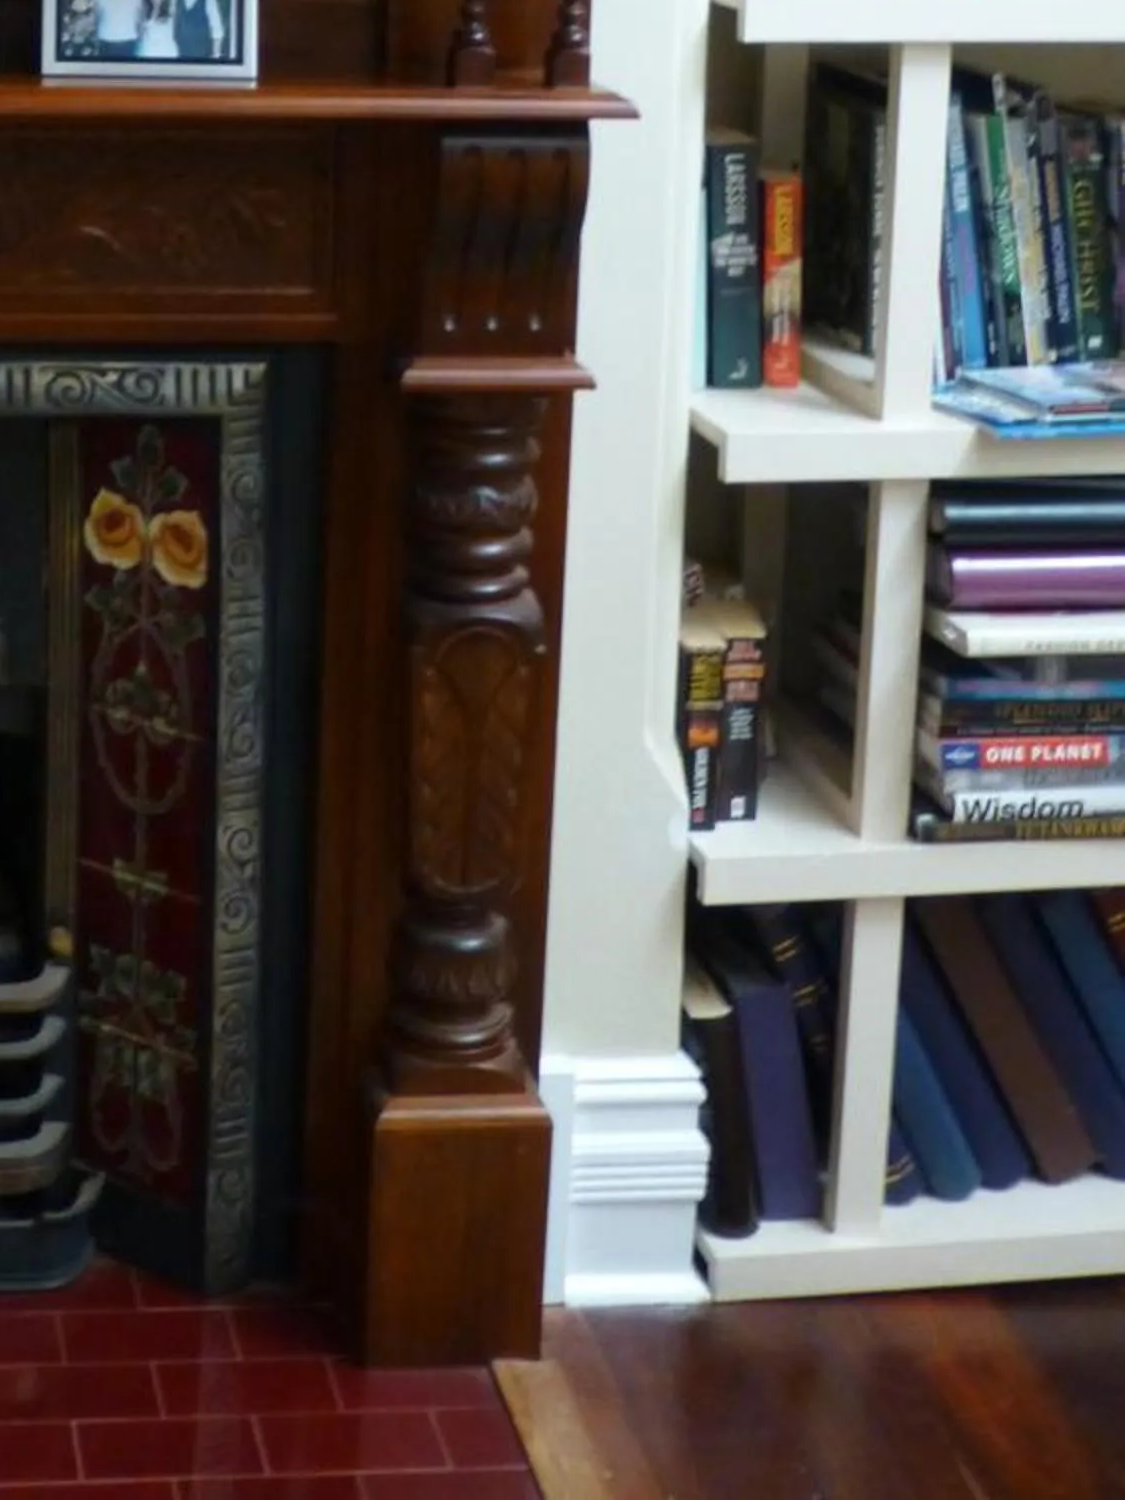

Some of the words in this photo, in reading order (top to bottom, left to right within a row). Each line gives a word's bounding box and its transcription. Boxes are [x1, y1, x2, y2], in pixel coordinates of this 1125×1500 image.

[724, 152, 747, 226] LARSSON
[985, 745, 1026, 764] ONE
[1031, 742, 1104, 762] PLANET
[961, 796, 1085, 824] Wisdom
